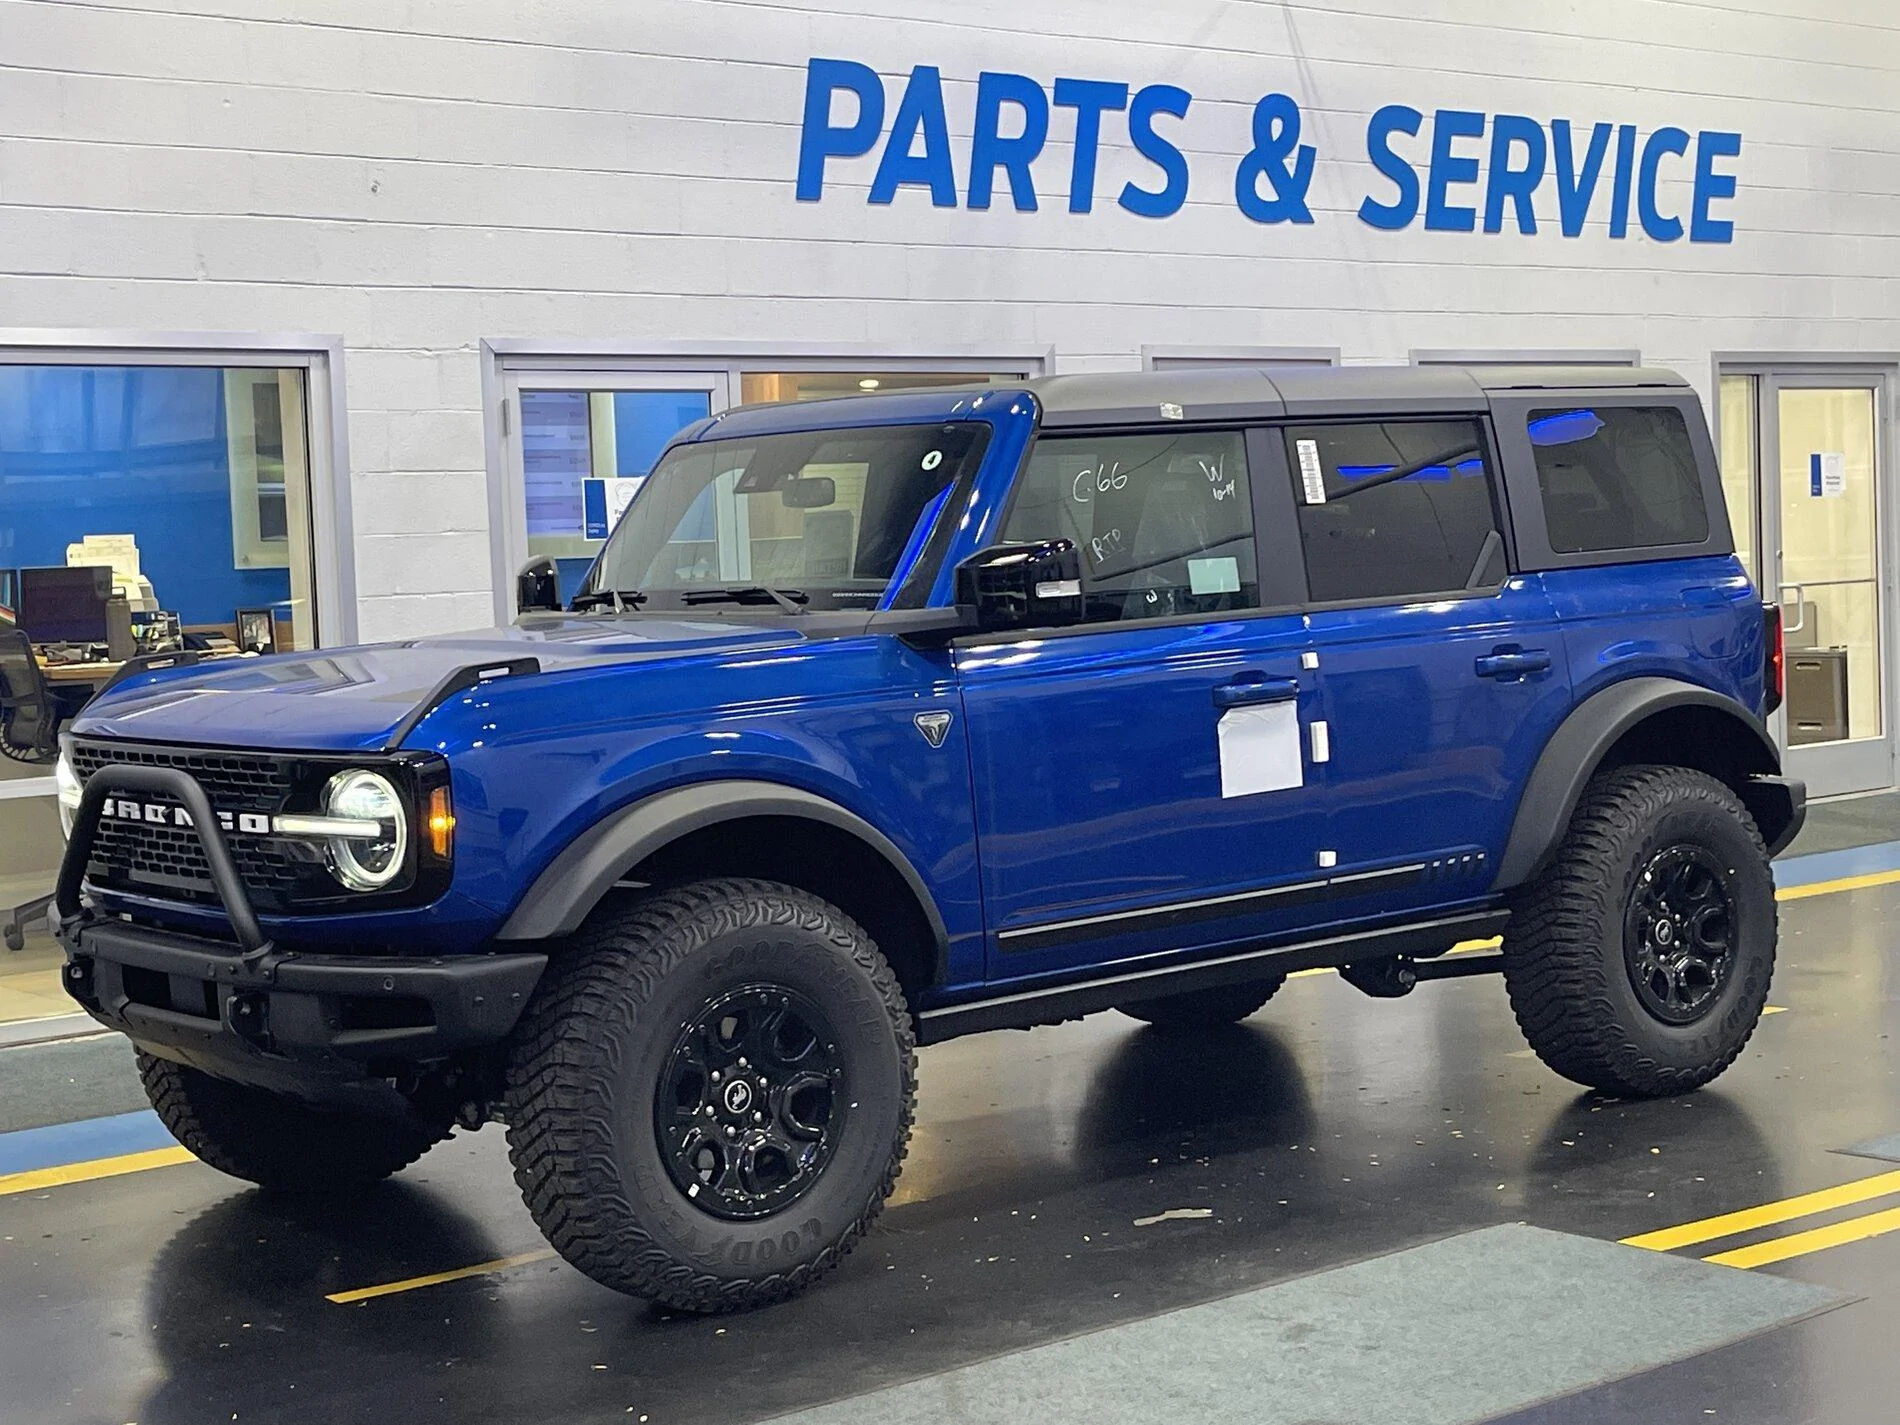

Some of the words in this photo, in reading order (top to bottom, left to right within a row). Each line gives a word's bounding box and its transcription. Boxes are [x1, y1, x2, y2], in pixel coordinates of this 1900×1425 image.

[797, 58, 1192, 217] PARTS
[1236, 94, 1316, 223] &
[1358, 106, 1740, 242] SERVICE
